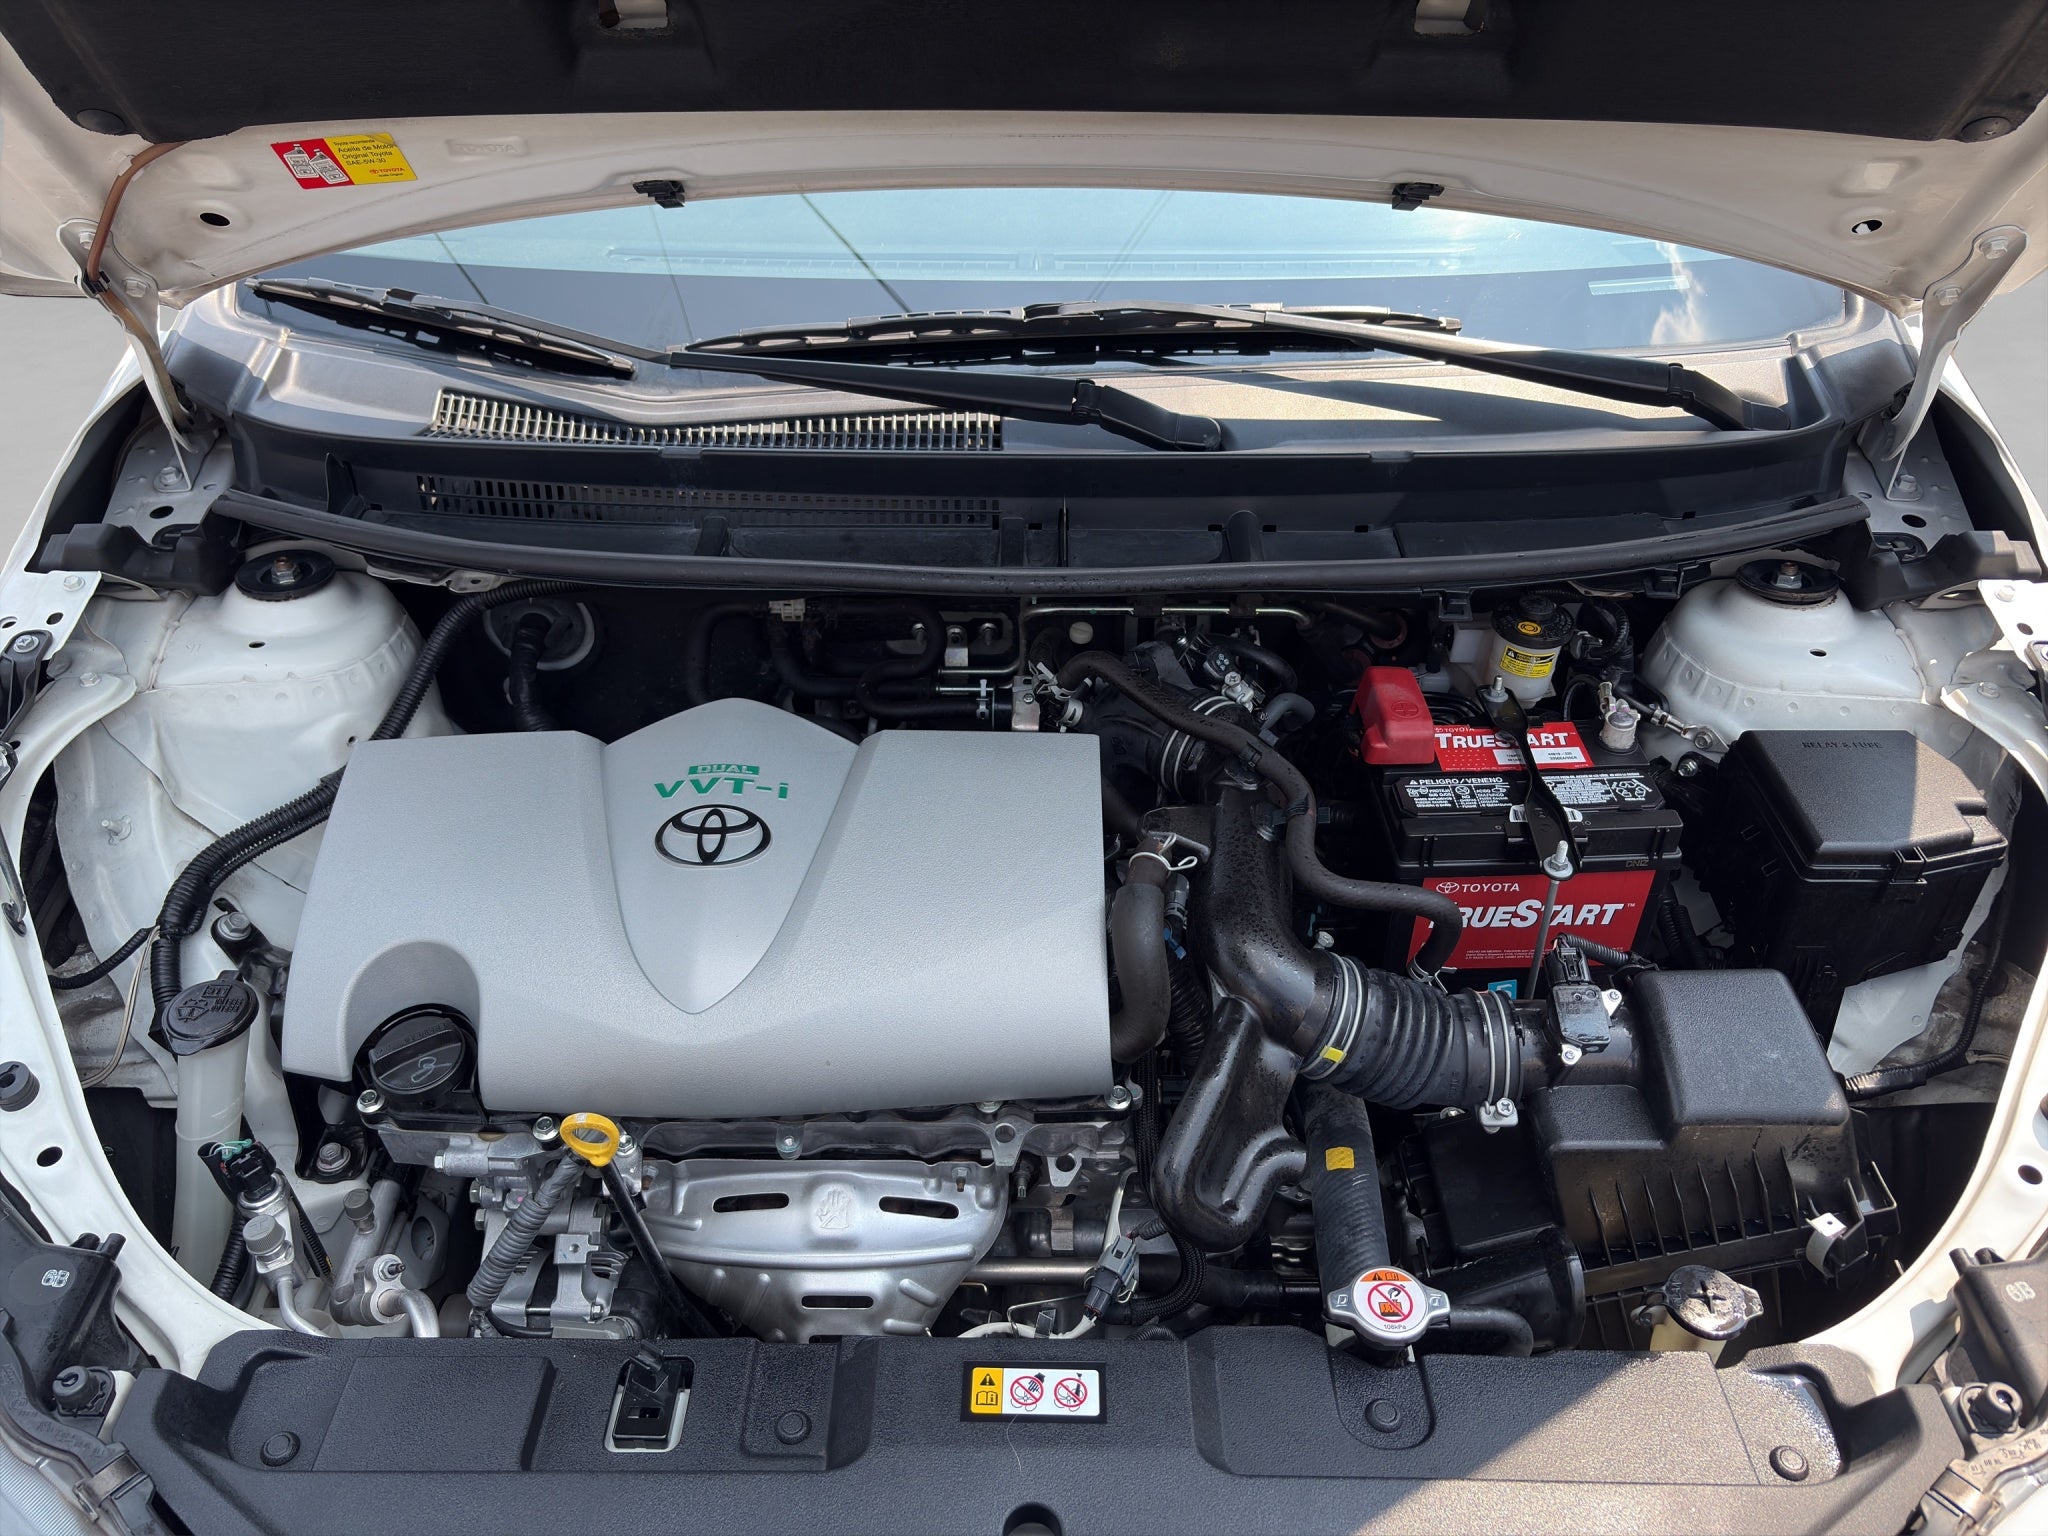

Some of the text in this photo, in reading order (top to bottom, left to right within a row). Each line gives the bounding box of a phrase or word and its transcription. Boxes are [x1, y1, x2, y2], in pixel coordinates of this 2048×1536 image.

[1434, 732, 1568, 749] TRUESART
[697, 764, 753, 775] DUAL
[654, 777, 790, 800] VVT-i
[1462, 882, 1520, 893] TOYOTA
